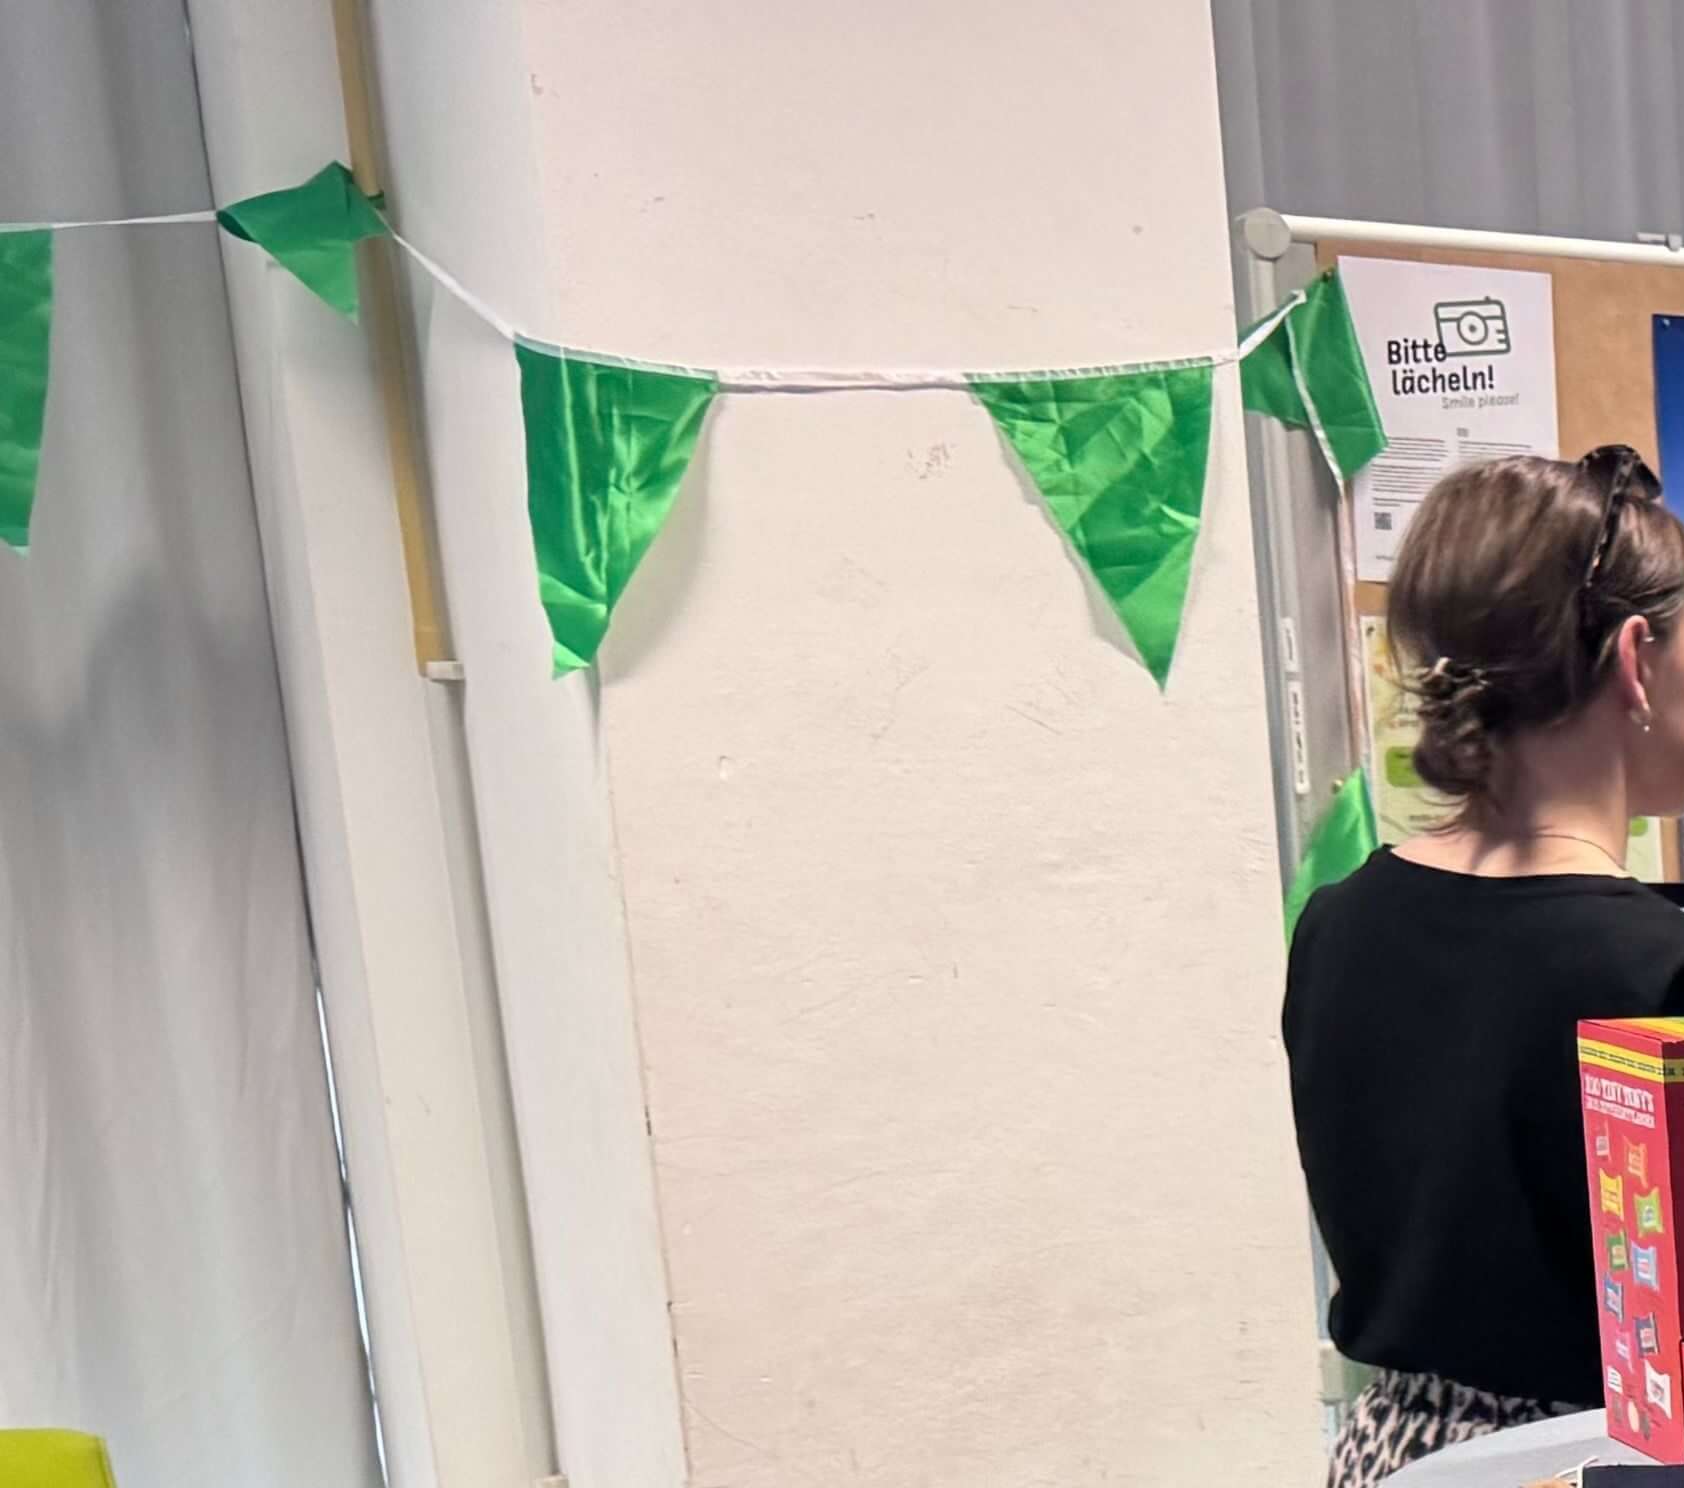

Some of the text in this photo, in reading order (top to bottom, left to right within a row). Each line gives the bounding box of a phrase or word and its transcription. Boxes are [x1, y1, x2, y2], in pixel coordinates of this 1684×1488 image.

[1387, 339, 1447, 365] Bitte
[1391, 365, 1494, 395] lächeln!
[1442, 396, 1475, 410] Smile
